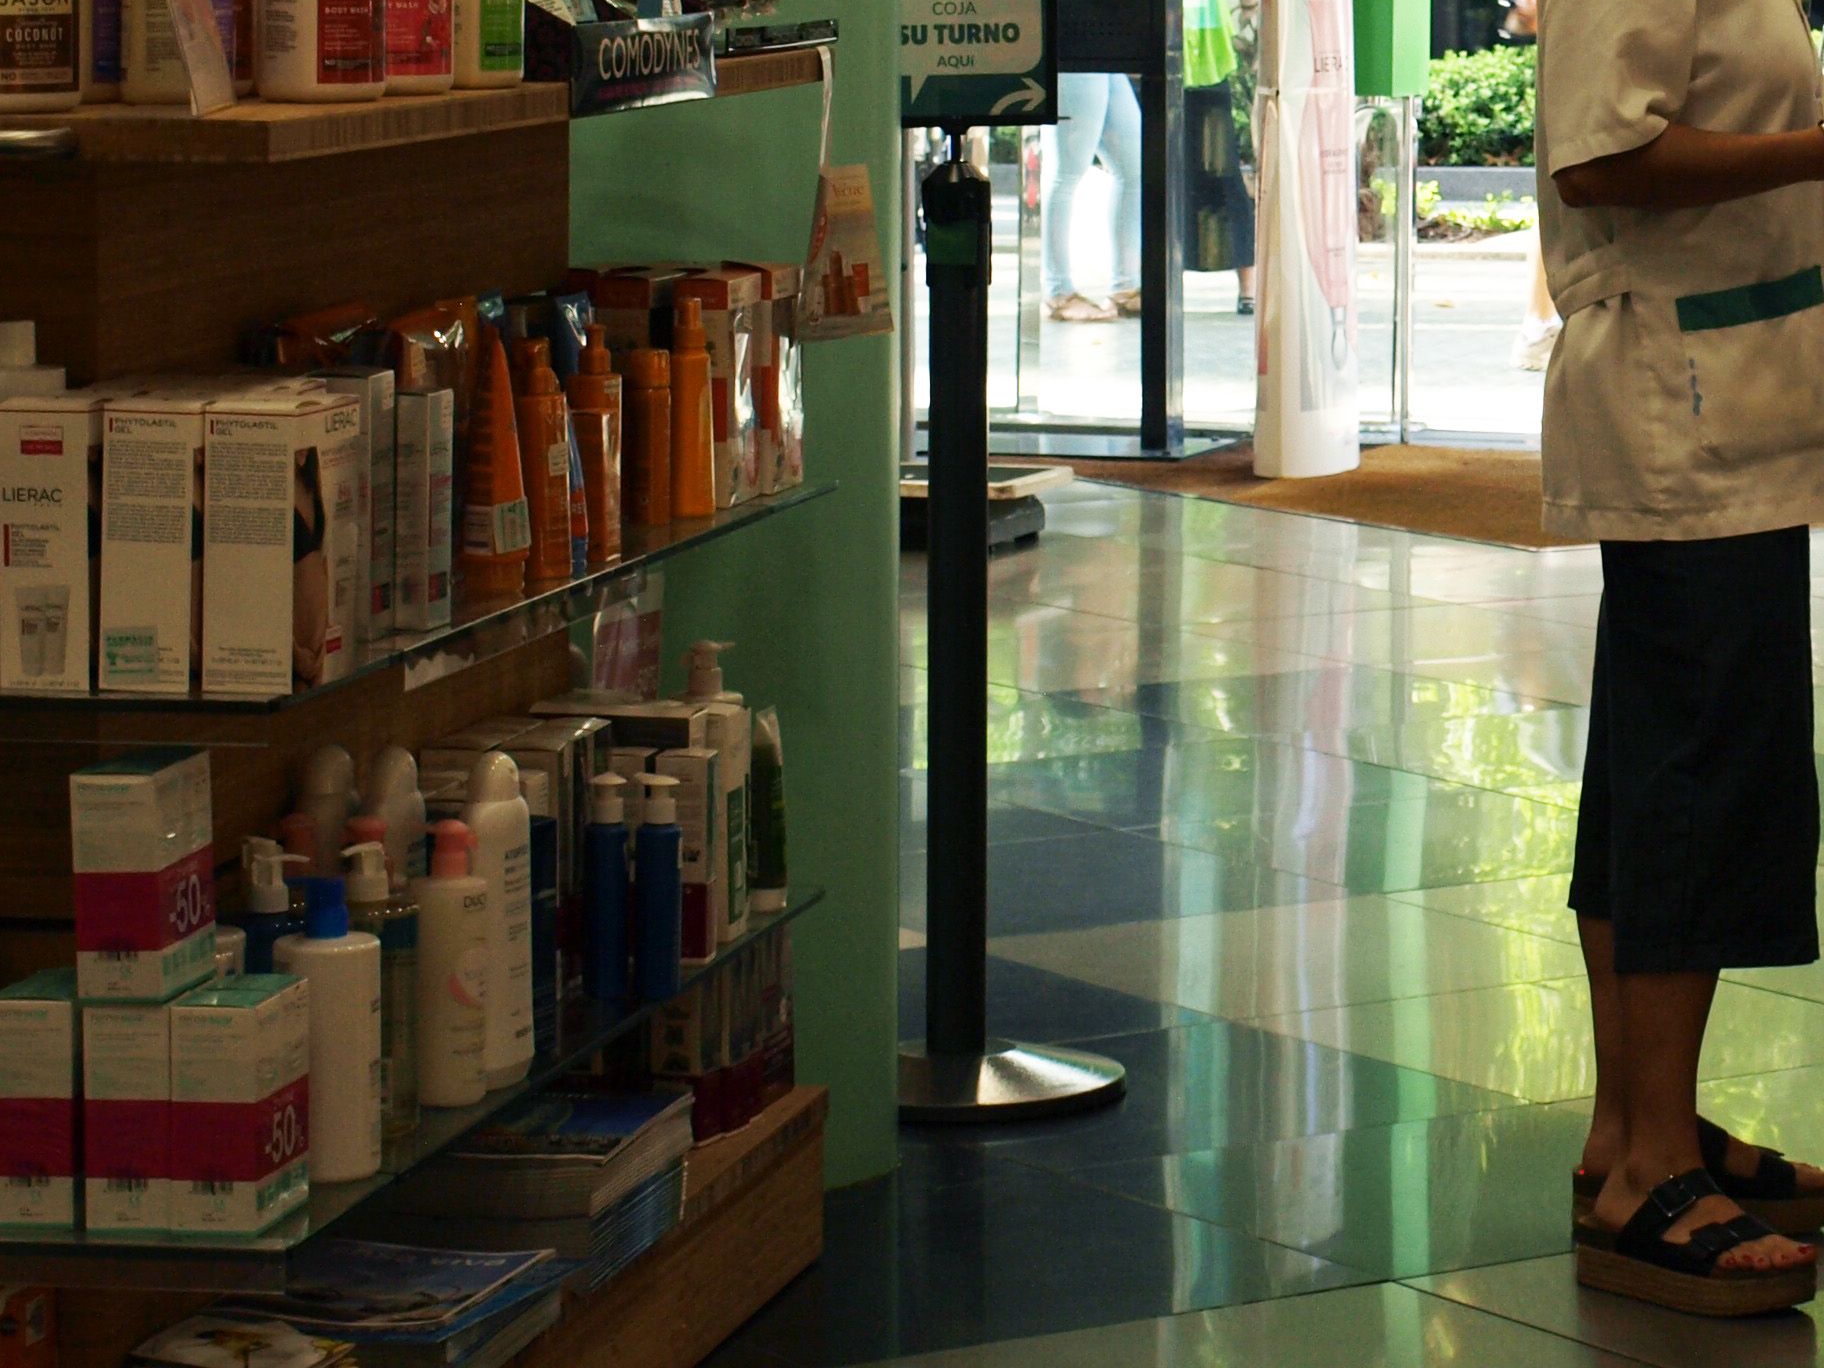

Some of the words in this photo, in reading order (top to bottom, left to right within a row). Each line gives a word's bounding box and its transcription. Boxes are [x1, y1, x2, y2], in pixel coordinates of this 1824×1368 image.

[932, 1, 977, 15] COJA
[6, 27, 63, 42] COCONUT
[933, 23, 1020, 44] TURNO
[599, 29, 700, 80] COMODYNES
[2, 487, 63, 503] LIERAC
